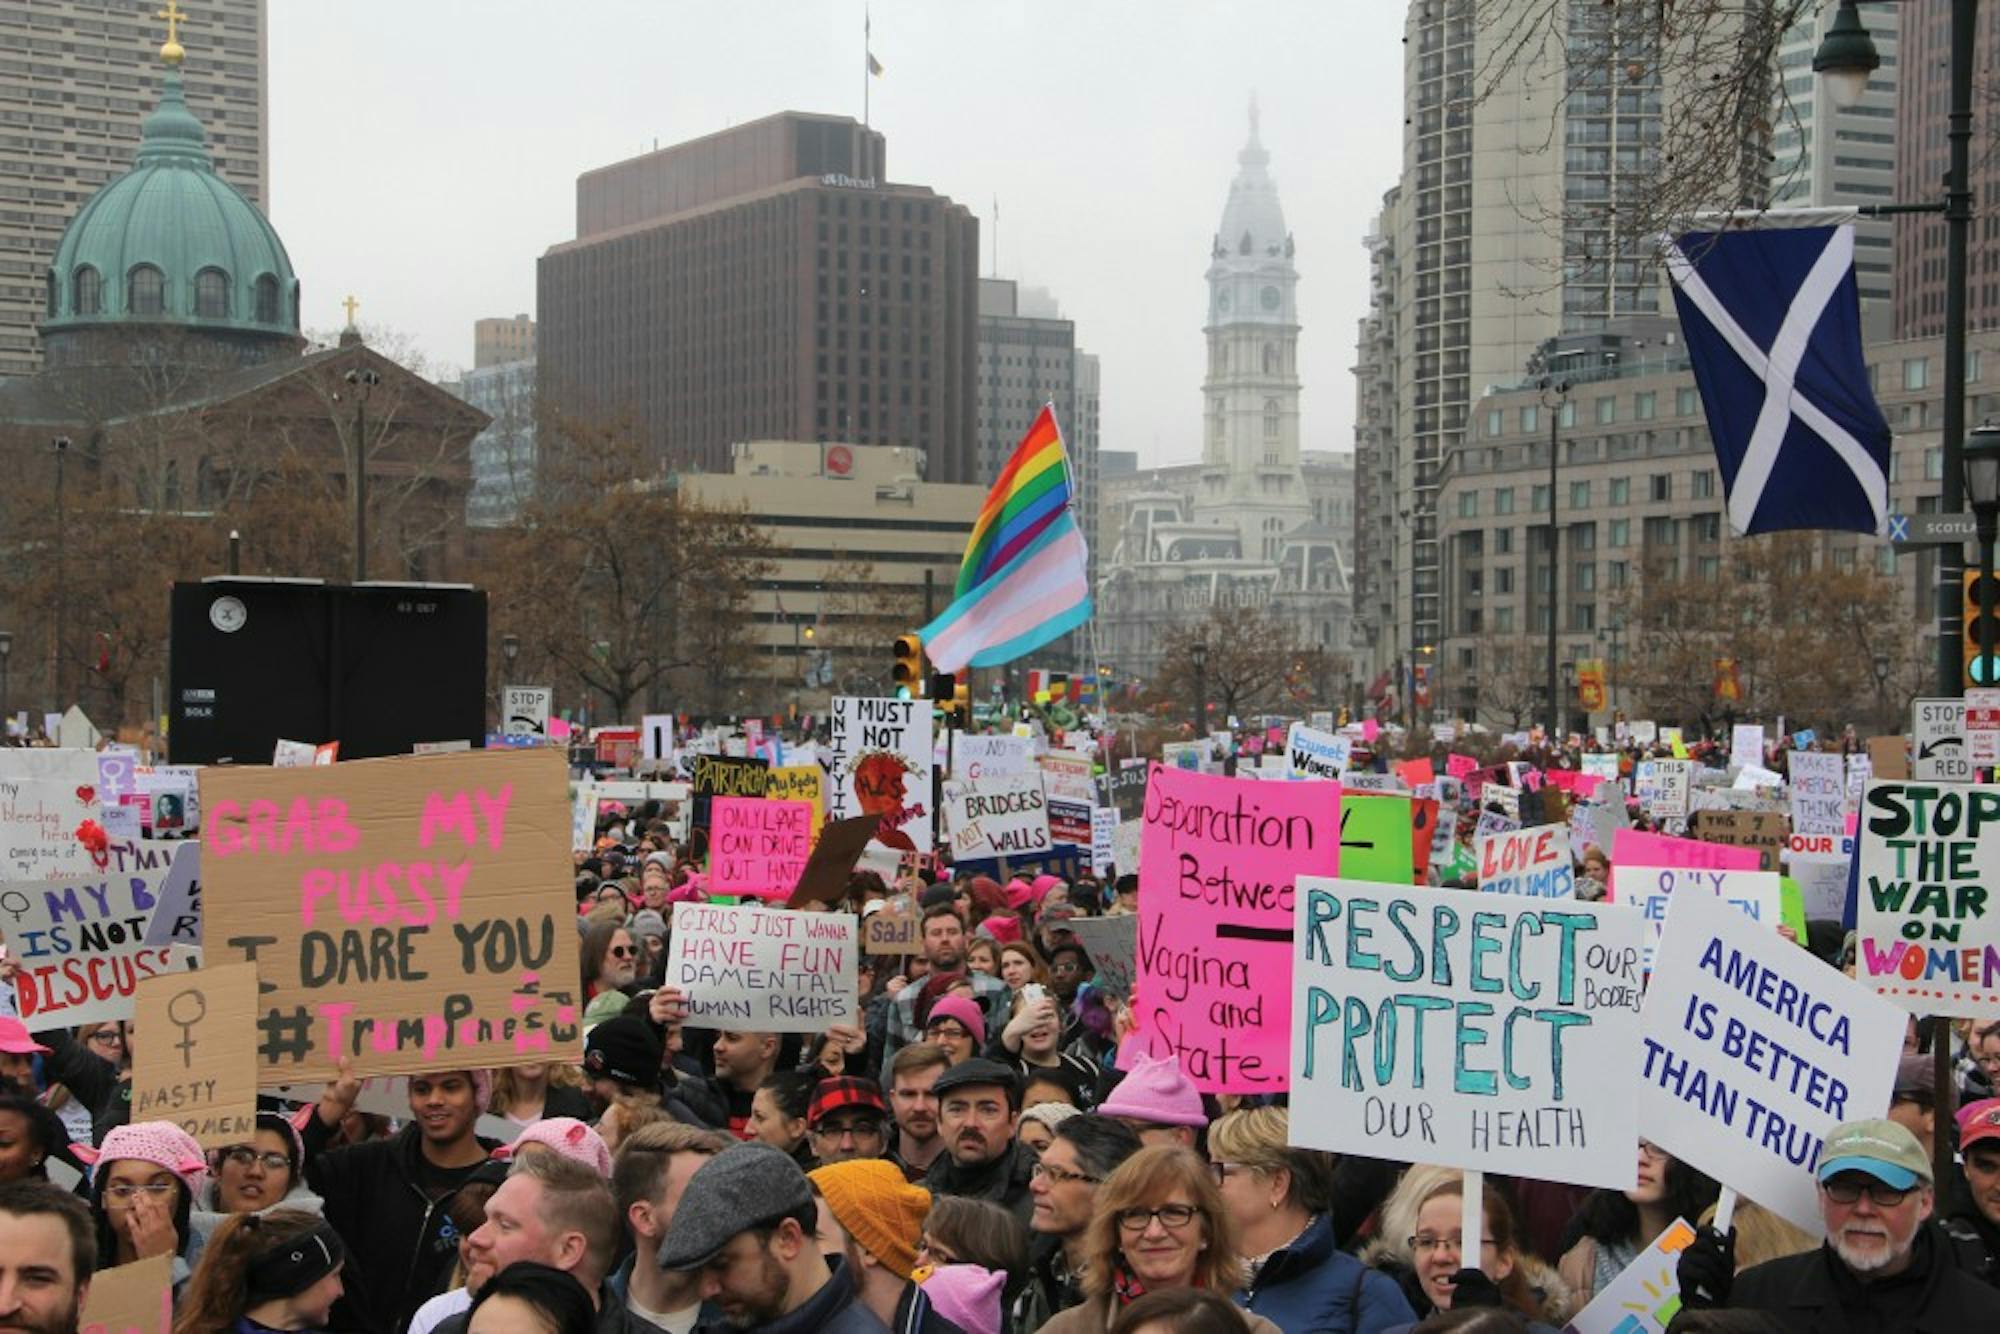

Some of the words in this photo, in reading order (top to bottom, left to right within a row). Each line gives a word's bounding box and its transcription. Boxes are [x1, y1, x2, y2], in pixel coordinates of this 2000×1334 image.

[511, 692, 545, 705] STOP
[858, 700, 914, 724] MUST
[1923, 705, 1965, 722] STOP
[863, 726, 905, 748] NOT
[1930, 723, 1957, 734] HERE
[1294, 731, 1345, 761] tweet
[1943, 747, 1959, 757] ON
[1656, 761, 1685, 773] THIS
[1793, 756, 1836, 773] MAKE
[1935, 760, 1968, 776] RED
[1791, 775, 1842, 796] AMERICA
[206, 796, 363, 858] GRAB
[419, 781, 514, 852] MY
[965, 789, 1043, 819] BRIDGES
[1146, 765, 1313, 850] Separation
[1799, 799, 1843, 819] THINK
[1867, 784, 2000, 839] STOP
[986, 826, 1047, 852] WALLS
[1482, 830, 1558, 878] LOVE
[1790, 835, 1833, 853] OUR
[1885, 839, 1981, 883] THE
[301, 858, 474, 928] PUSSY
[1180, 853, 1294, 911] Betwee
[1867, 875, 1989, 920] WAR
[43, 887, 111, 925] MY
[130, 877, 158, 912] B
[18, 926, 73, 958] IS
[80, 916, 147, 951] NOT
[679, 908, 738, 937] GIRLS
[751, 913, 796, 939] JUST
[805, 918, 849, 941] WANNA
[1901, 920, 1962, 943] ON
[227, 935, 278, 994] I
[301, 924, 430, 989] DARE
[452, 913, 555, 975] YOU
[681, 938, 756, 967] HAVE
[779, 942, 843, 975] FUN
[1140, 912, 1250, 1003] Vagina
[1304, 888, 1599, 1007] RESPECT
[1585, 944, 1637, 983] OUR
[681, 963, 849, 994] DAMENTAL
[1584, 977, 1642, 1013] BODIES
[677, 990, 751, 1019] HUMAN
[768, 995, 847, 1018] RIGHTS
[1208, 995, 1263, 1029] and
[1698, 936, 1851, 1056] AMERICA
[1150, 1007, 1285, 1086] State.
[1302, 985, 1593, 1102] PROTECT
[1683, 994, 1719, 1041] IS
[1721, 1017, 1850, 1122] BETTER
[139, 1079, 216, 1113] NASTY
[1643, 1037, 1739, 1127] THAN
[180, 1116, 251, 1137] OMEN
[1363, 1096, 1437, 1145] OUR
[1470, 1106, 1586, 1152] HEALTH
